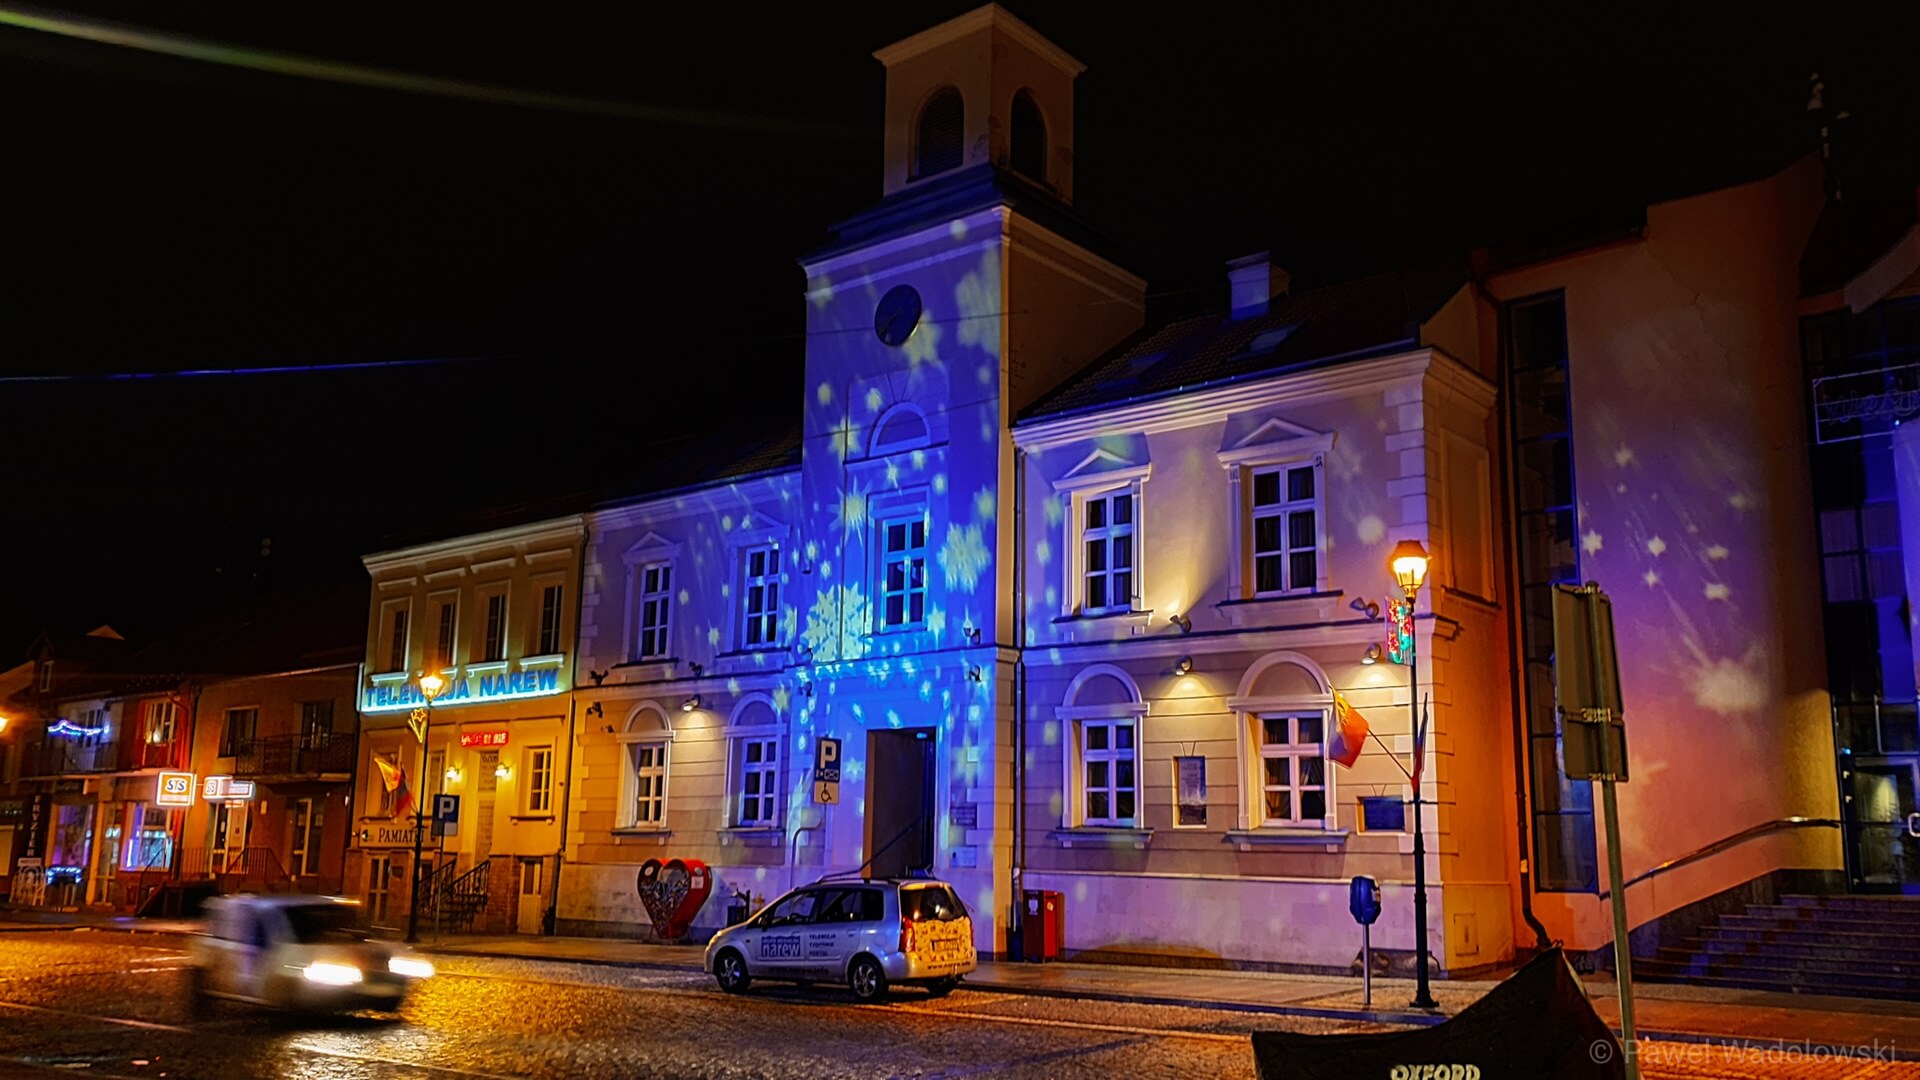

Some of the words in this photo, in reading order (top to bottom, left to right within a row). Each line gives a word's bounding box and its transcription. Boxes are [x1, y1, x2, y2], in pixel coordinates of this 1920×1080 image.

[366, 680, 470, 708] TELEWJA
[479, 668, 559, 697] NAREW
[820, 740, 836, 769] P
[167, 780, 186, 791] STS
[438, 797, 455, 819] P
[762, 943, 800, 957] narew
[1390, 1063, 1481, 1080] OXFORD
